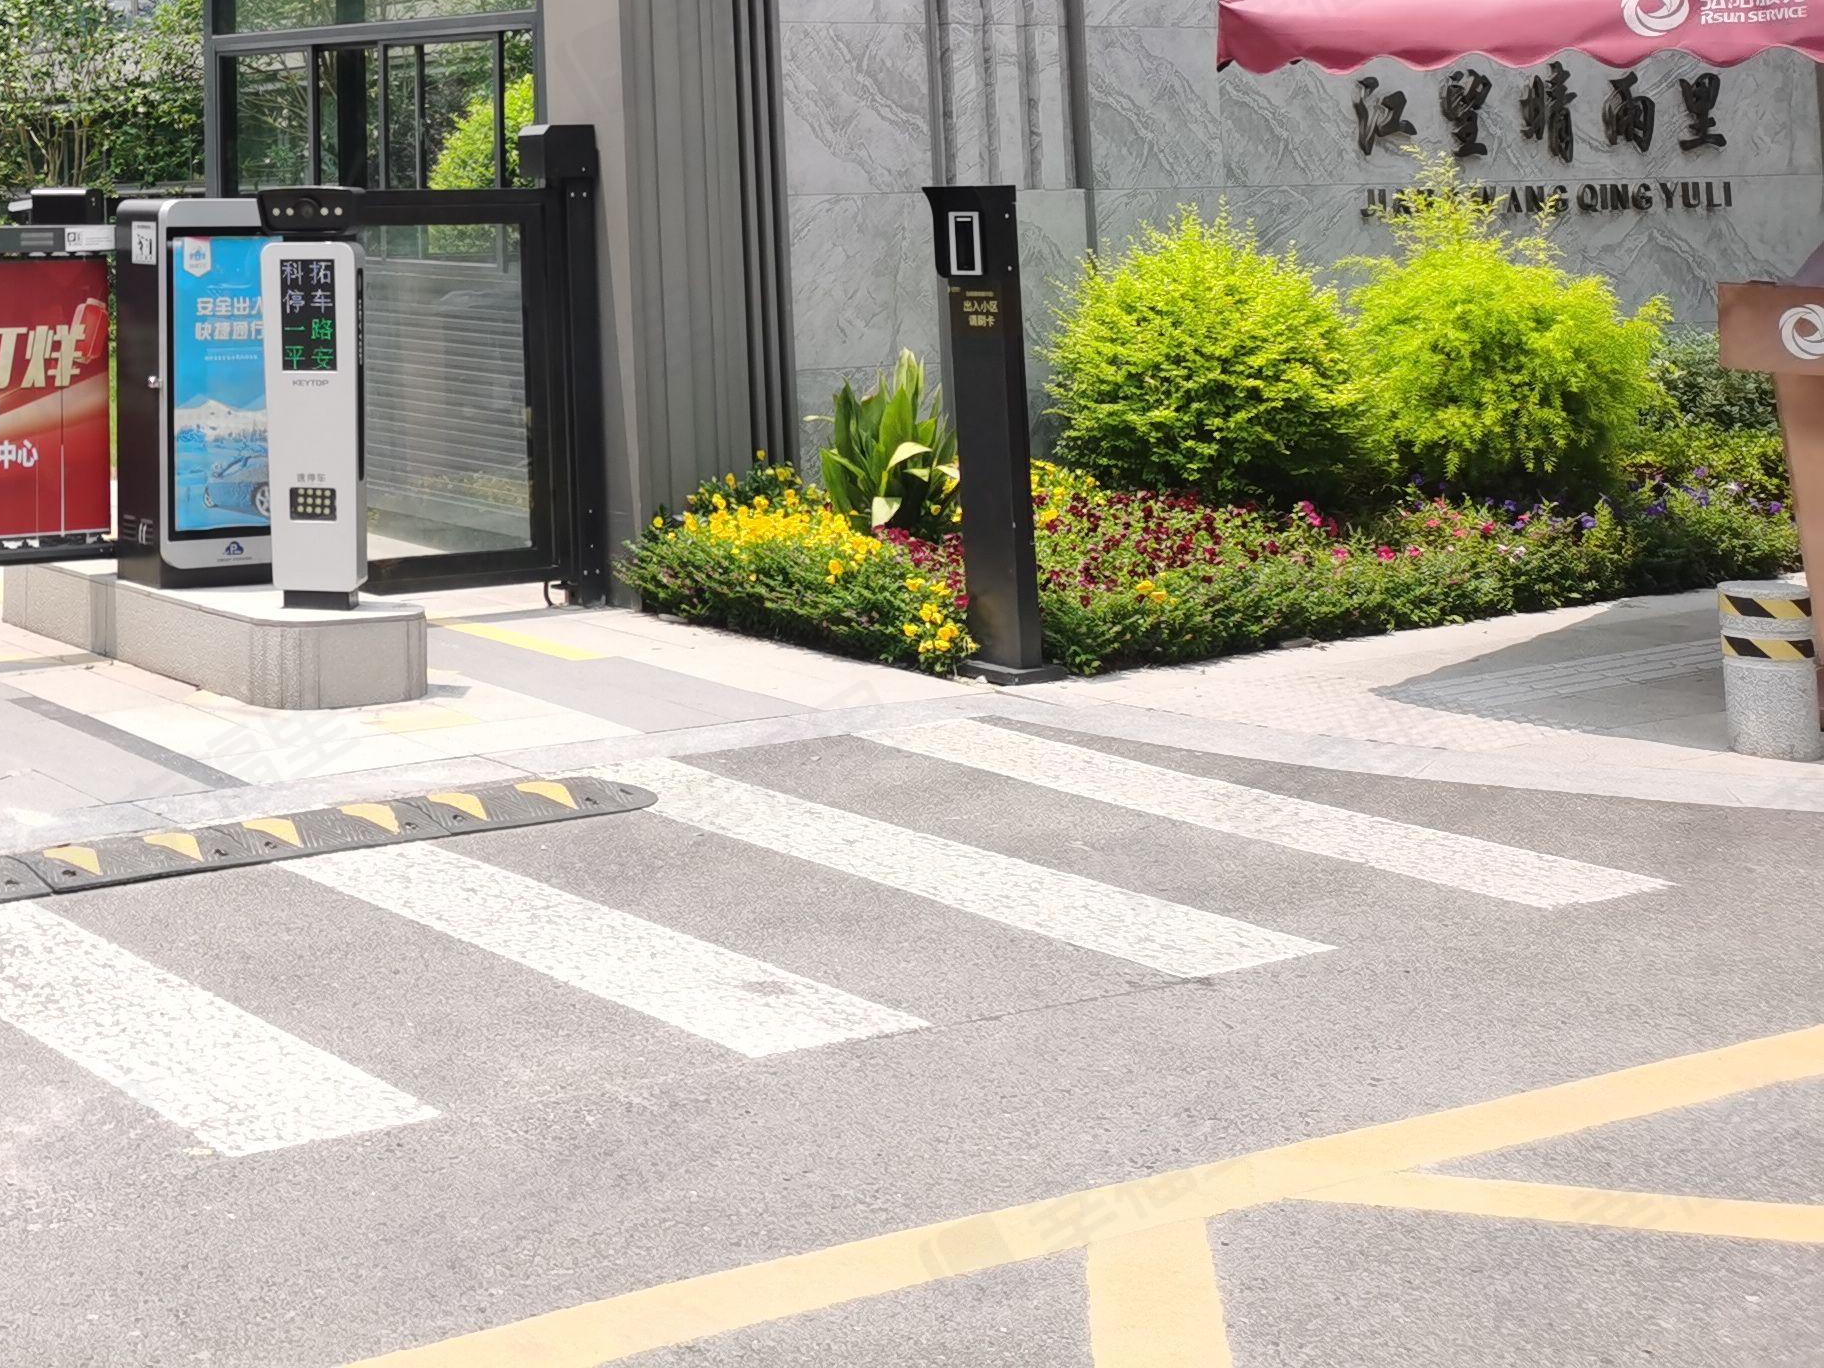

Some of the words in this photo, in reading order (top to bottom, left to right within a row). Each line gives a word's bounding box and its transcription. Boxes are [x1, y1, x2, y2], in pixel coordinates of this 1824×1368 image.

[1747, 6, 1808, 23] SERVICE
[281, 261, 332, 285] 科拓
[282, 289, 333, 314] 停车
[963, 300, 999, 312] 出入小区
[284, 318, 333, 340] 一路
[284, 345, 334, 370] 平安
